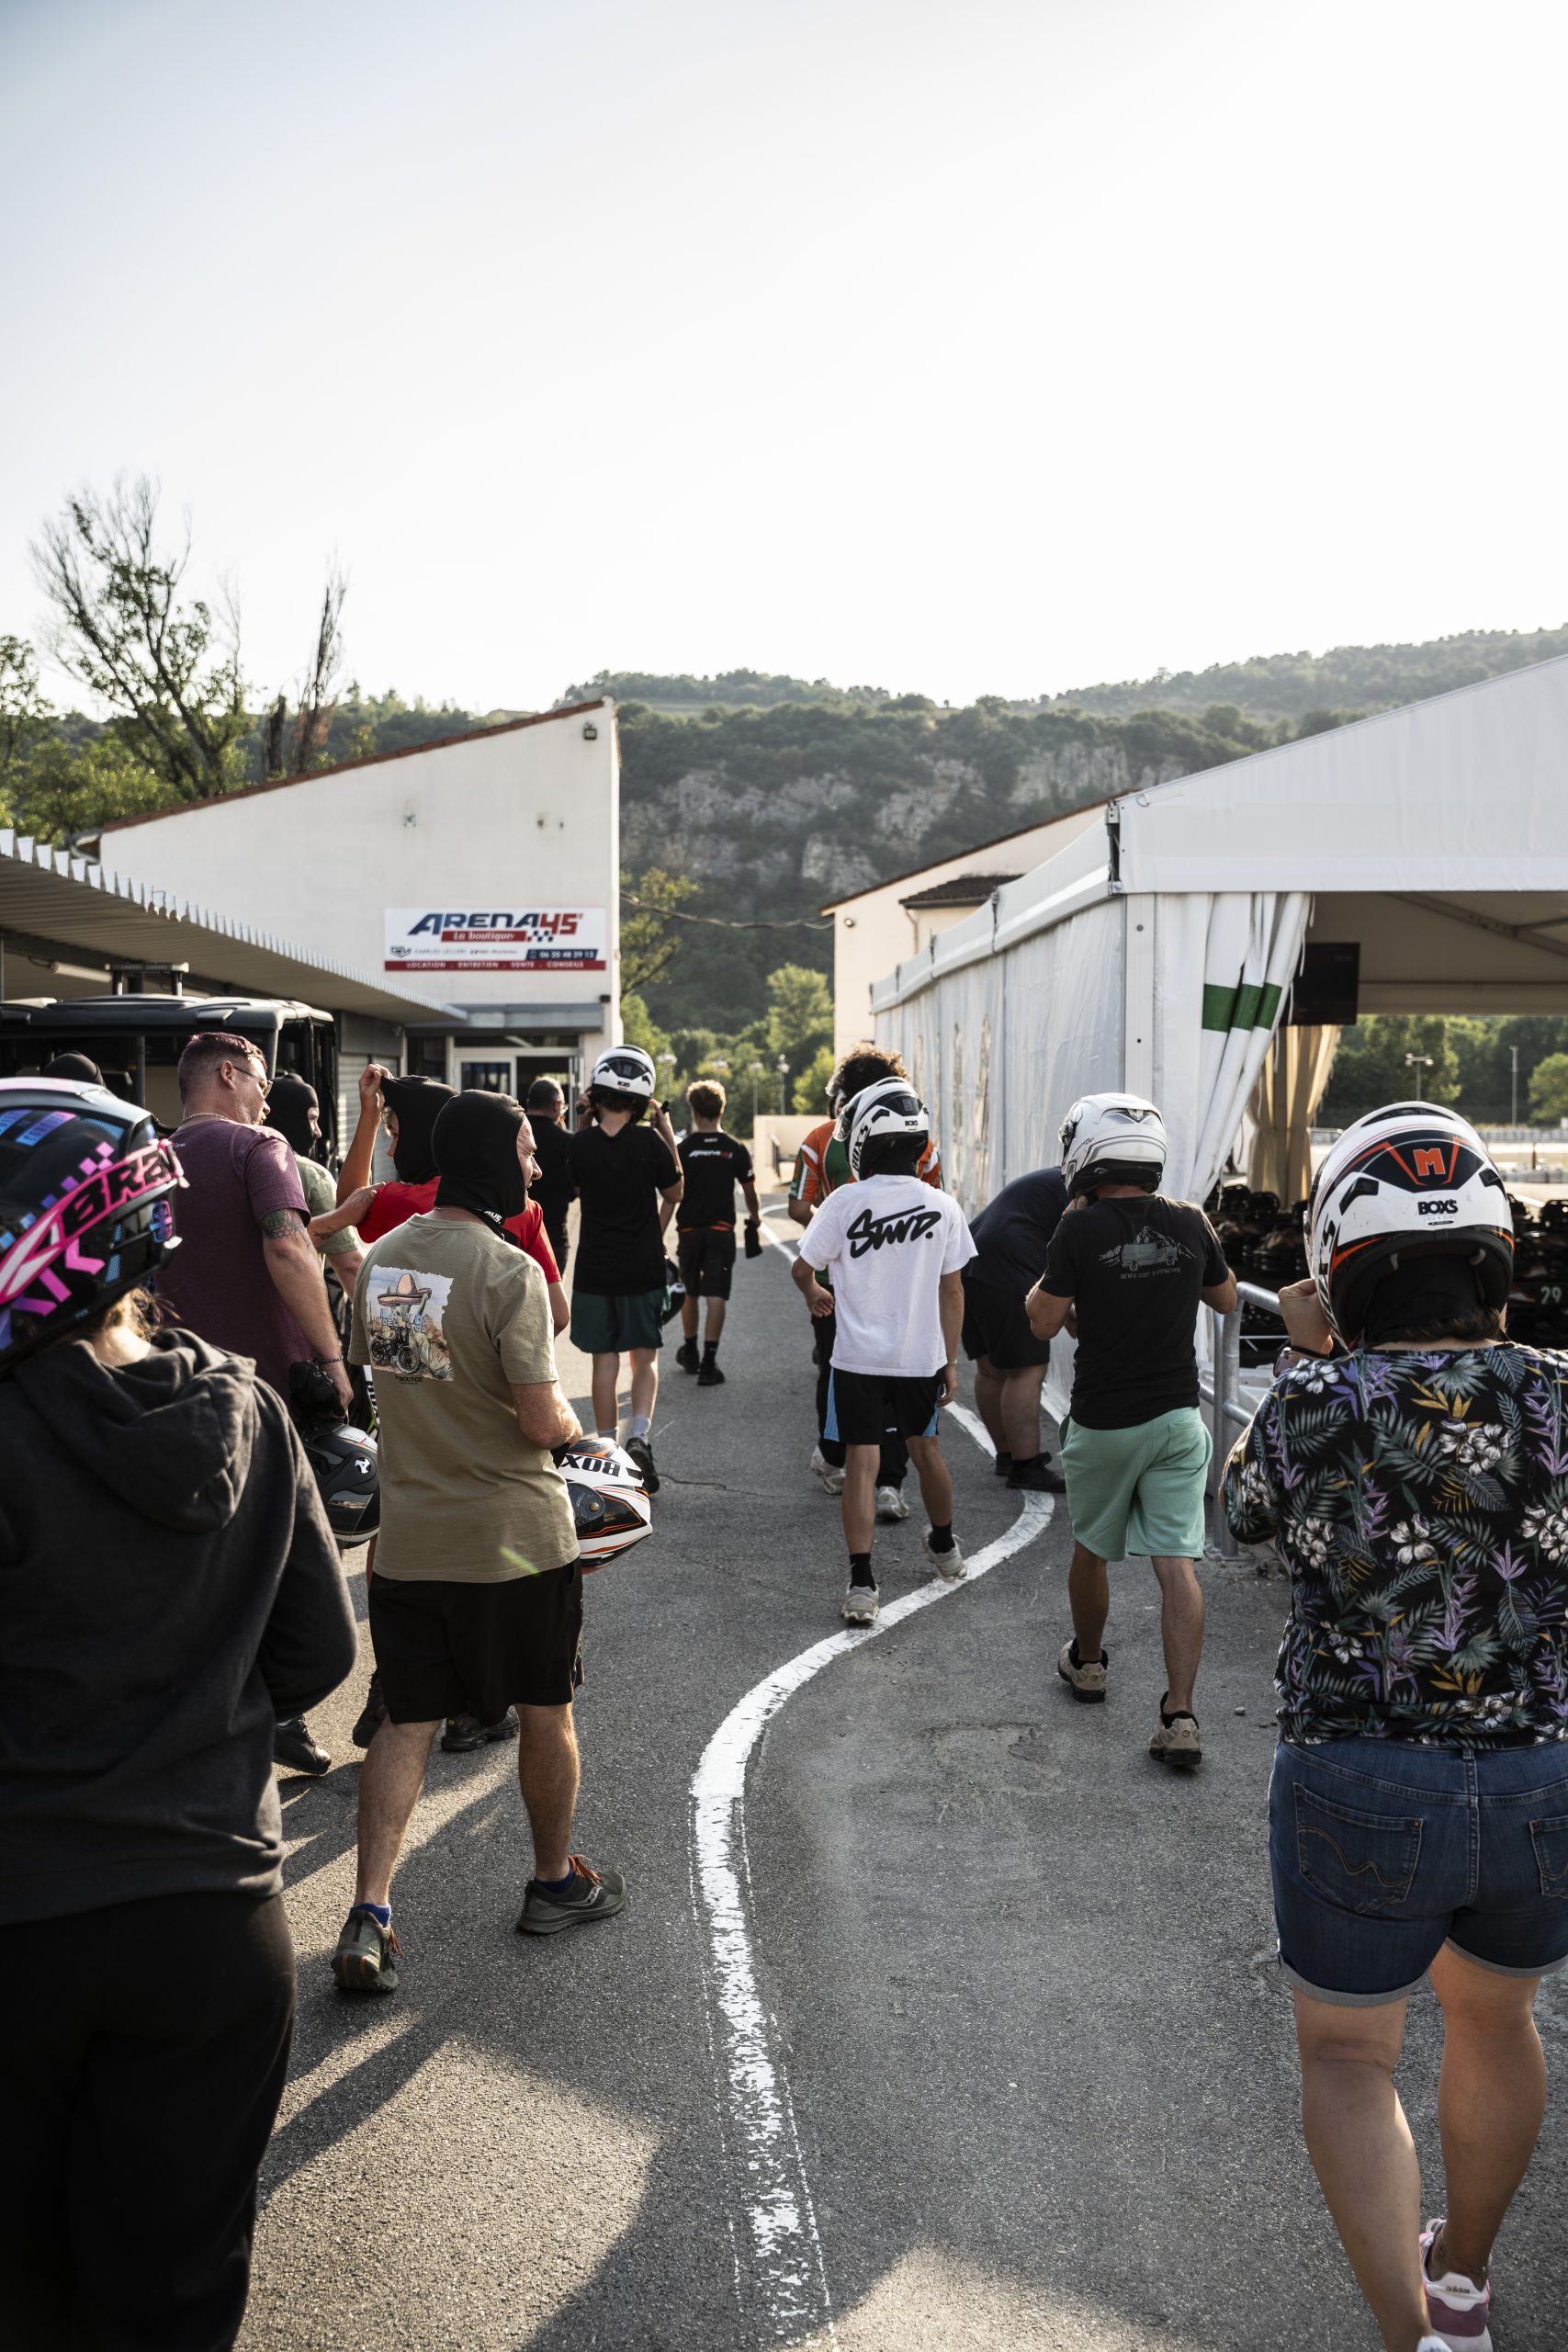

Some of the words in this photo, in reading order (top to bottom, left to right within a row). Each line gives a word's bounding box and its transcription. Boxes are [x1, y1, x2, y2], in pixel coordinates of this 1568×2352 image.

[469, 931, 515, 942] boutique
[1413, 1148, 1446, 1176] M
[1540, 1285, 1562, 1306] 29
[1445, 2285, 1471, 2294] adidas
